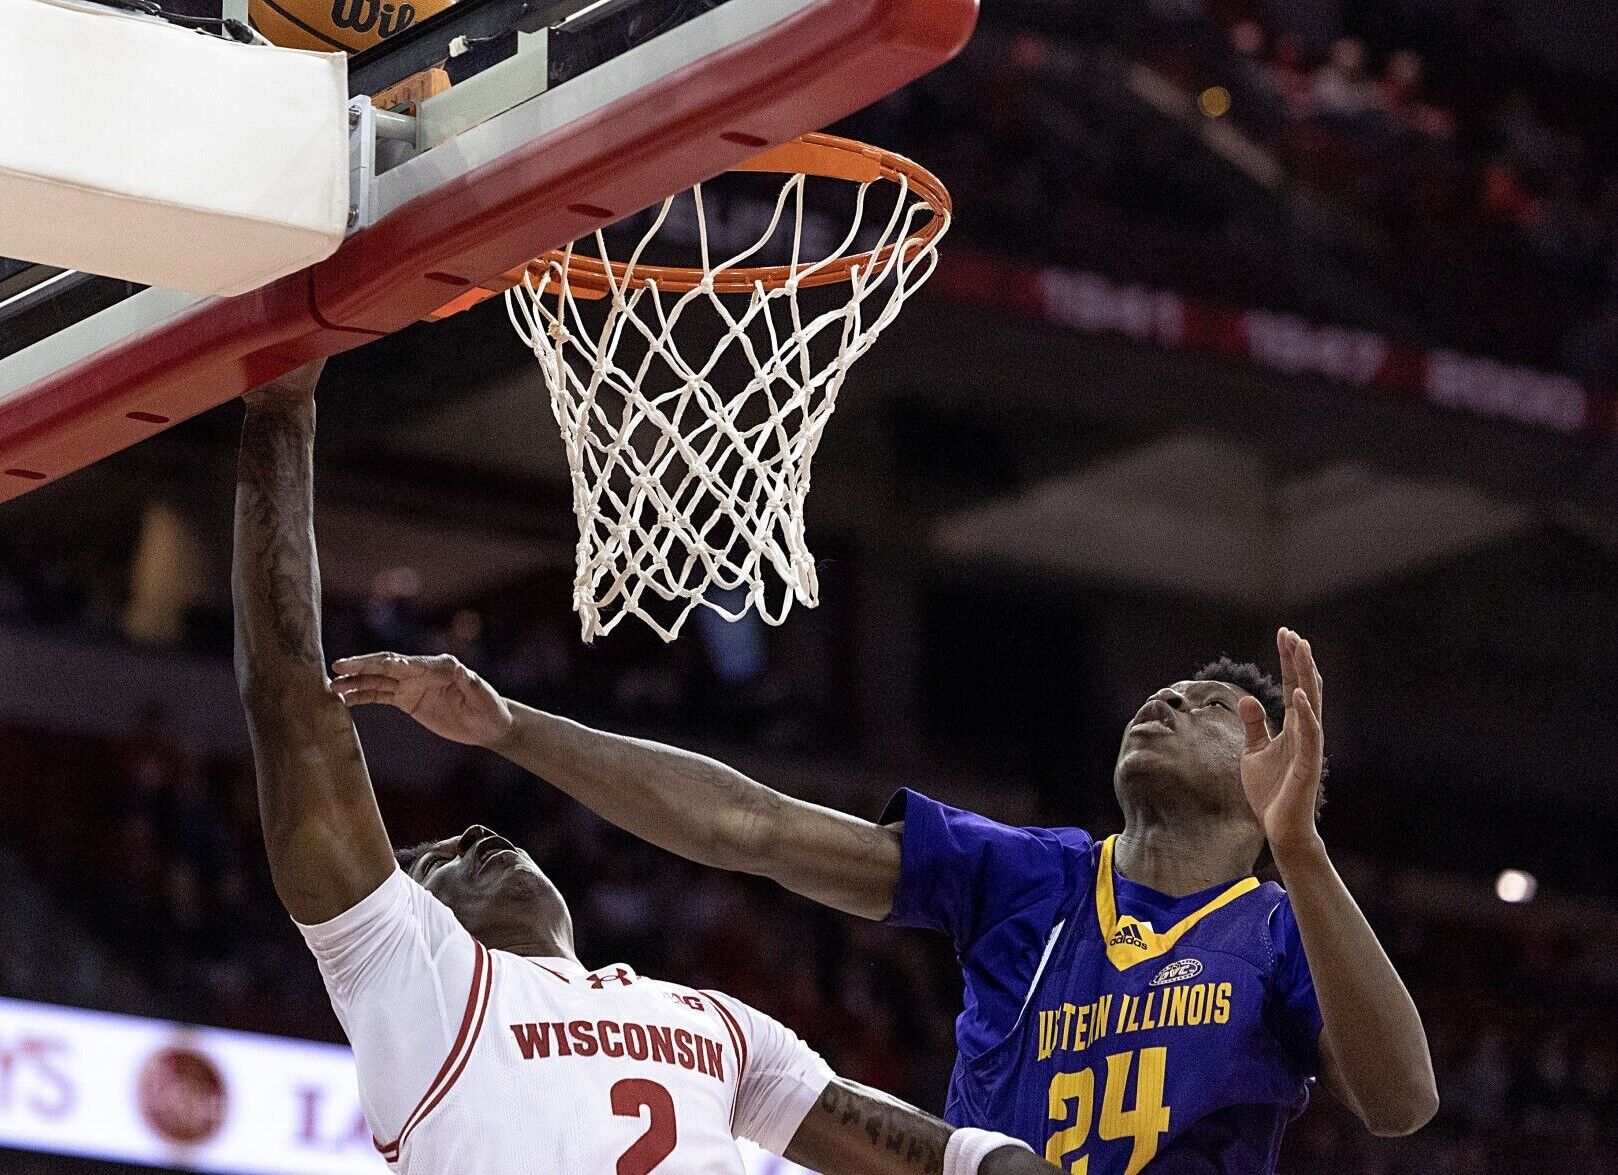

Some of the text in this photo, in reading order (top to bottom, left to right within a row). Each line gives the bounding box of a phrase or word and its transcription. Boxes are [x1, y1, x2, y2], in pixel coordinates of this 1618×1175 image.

[331, 0, 418, 38] Wil
[1109, 934, 1148, 951] adidas
[1115, 982, 1232, 1034] ILLINOIS
[509, 1020, 725, 1083] WISCONSIN
[610, 1078, 677, 1175] 2
[1046, 1047, 1171, 1175] 24
